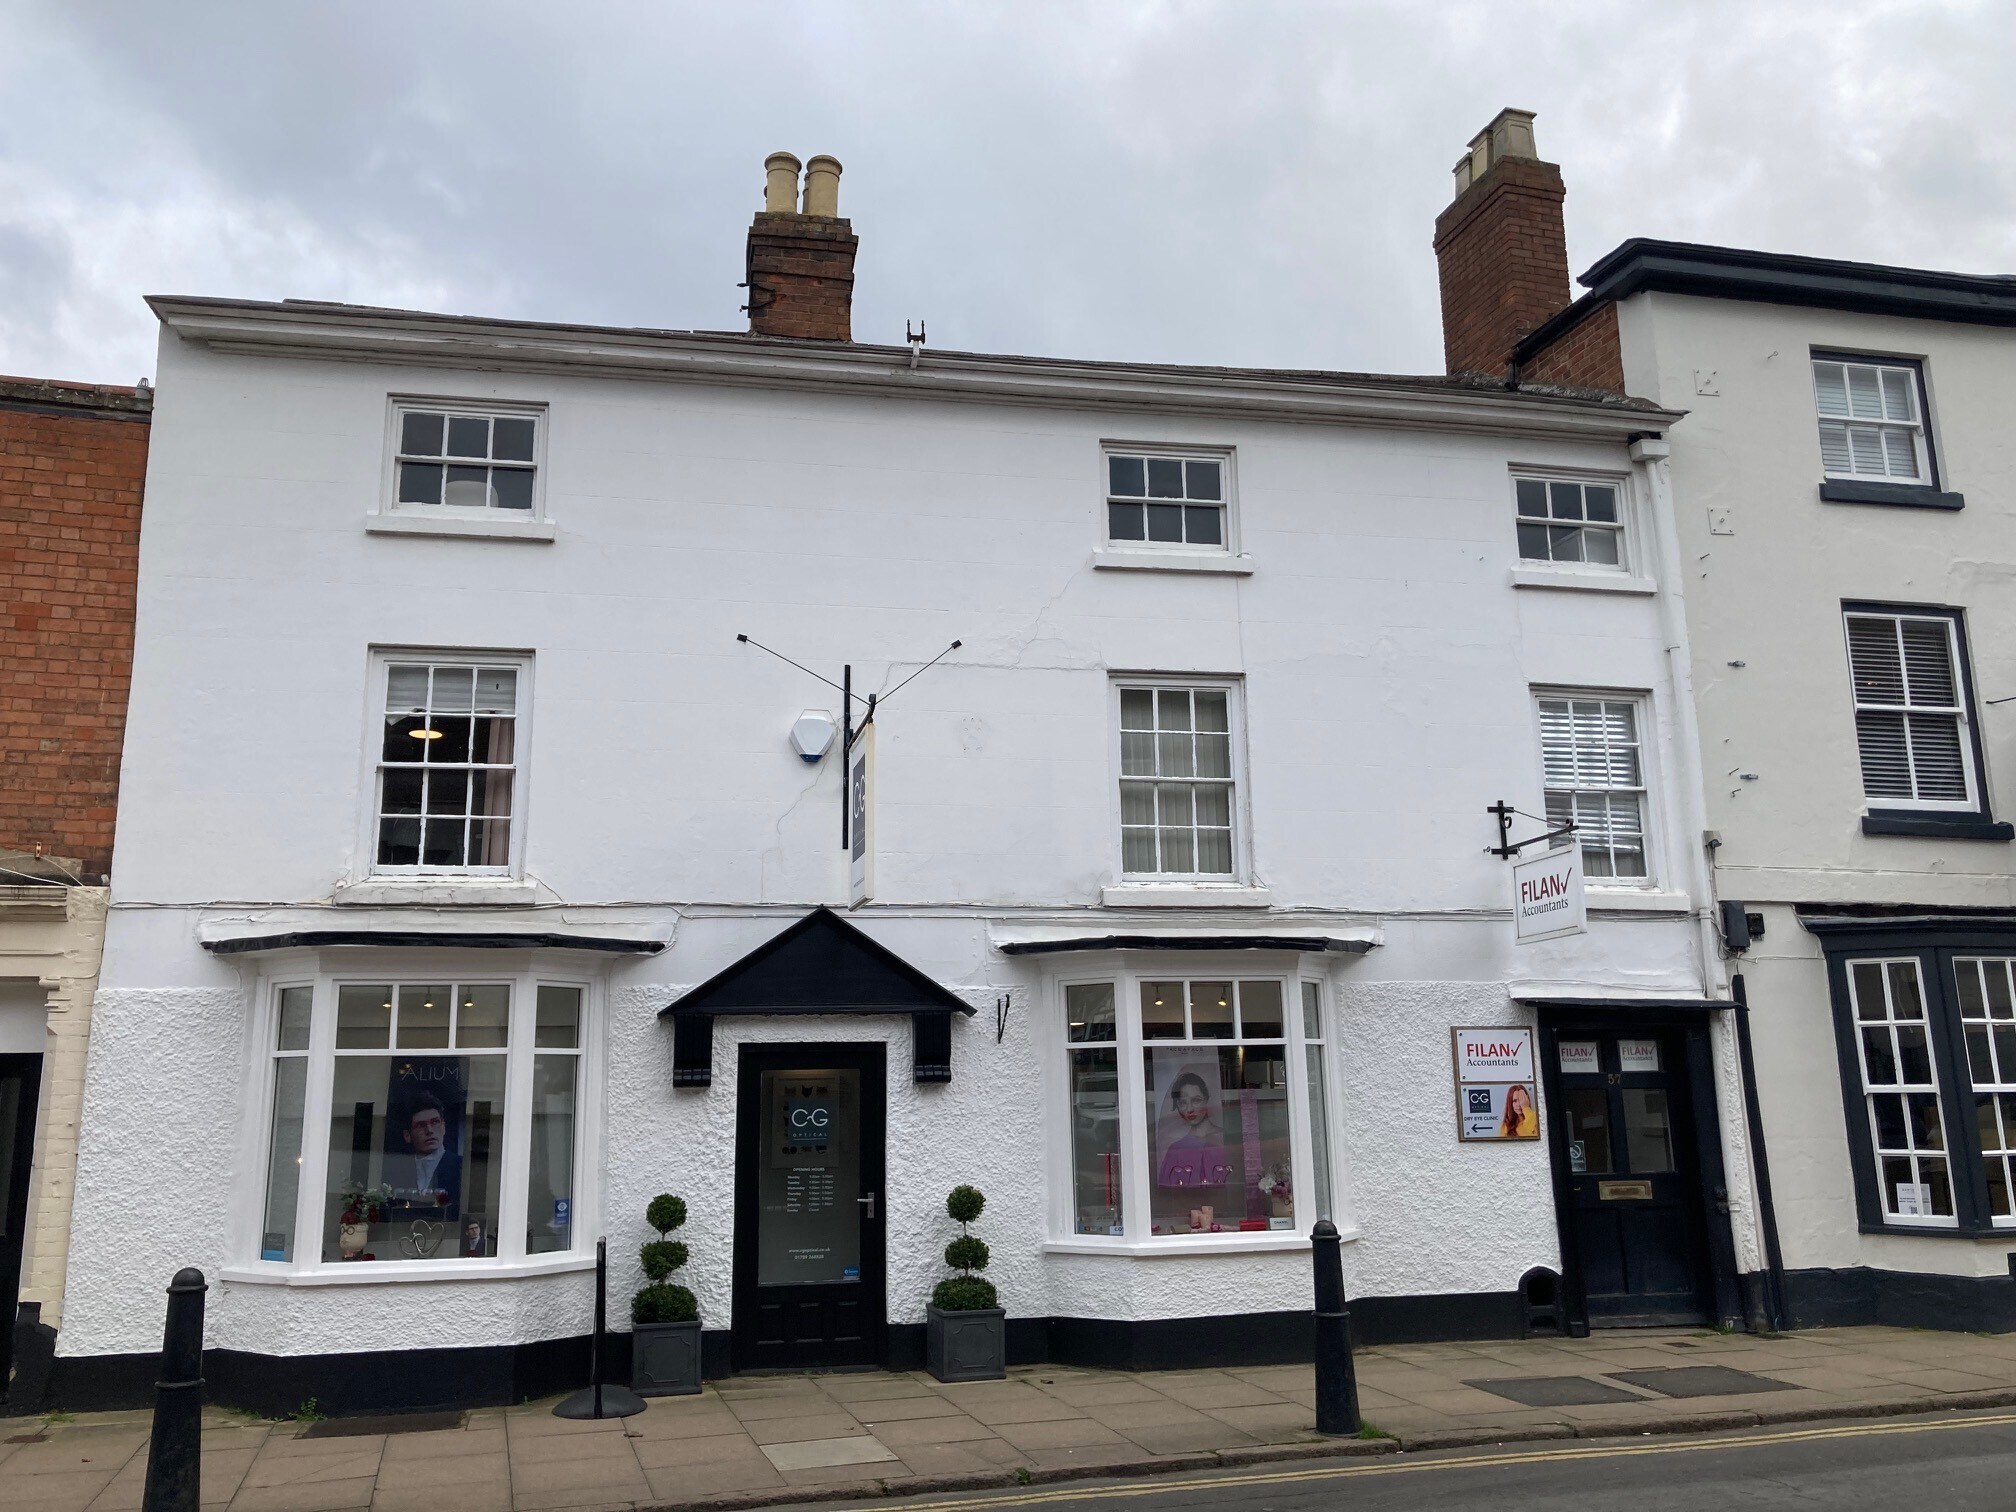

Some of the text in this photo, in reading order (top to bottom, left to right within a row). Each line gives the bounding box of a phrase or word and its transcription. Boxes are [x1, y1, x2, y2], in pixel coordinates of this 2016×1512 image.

[1521, 873, 1561, 904] FILAN
[1521, 898, 1569, 918] Accountants
[1466, 1043, 1511, 1057] FILAN
[1561, 1047, 1588, 1057] FILAN
[1621, 1046, 1649, 1056] FILAN
[1466, 1058, 1519, 1067] Accountants
[401, 1066, 460, 1081] ALIUM
[1470, 1093, 1489, 1104] CG
[791, 1108, 829, 1127] CG
